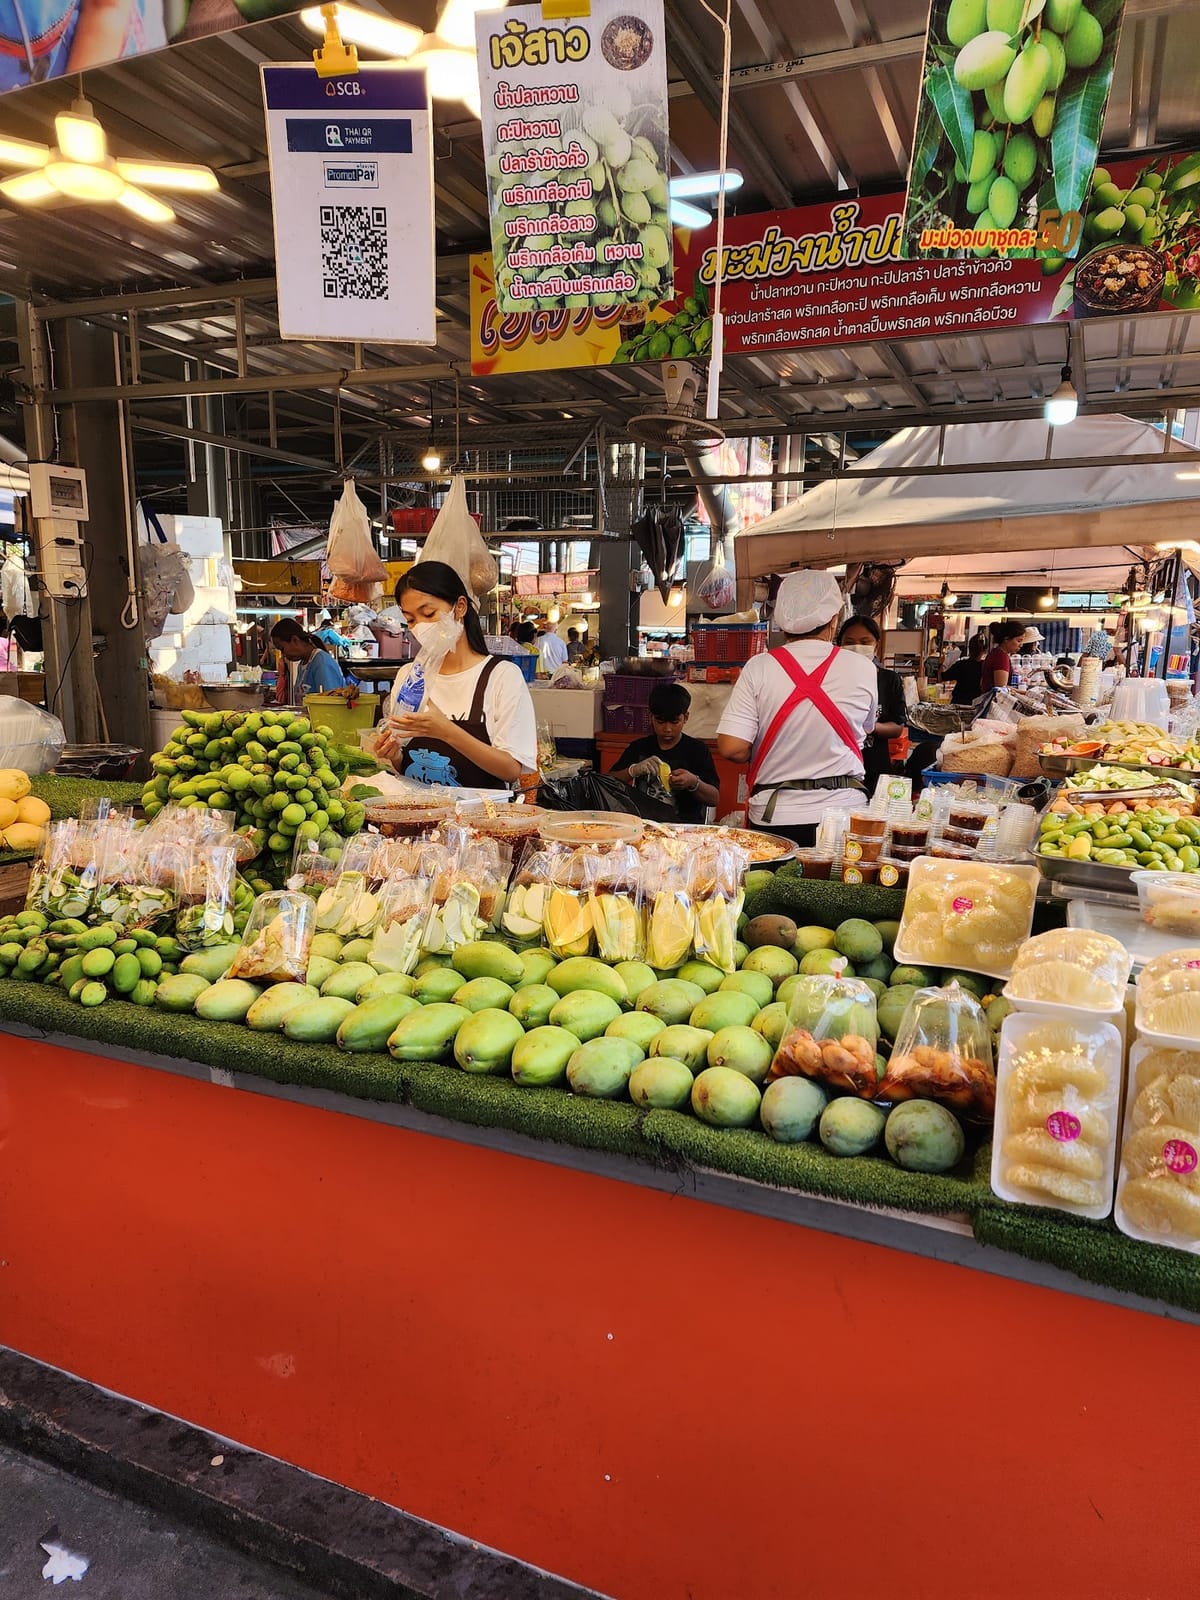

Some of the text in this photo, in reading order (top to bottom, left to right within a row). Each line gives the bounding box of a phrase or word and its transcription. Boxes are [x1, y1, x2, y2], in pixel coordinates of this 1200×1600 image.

[337, 81, 360, 96] SCB
[495, 81, 578, 108] น้ำปลาหวาน
[345, 127, 372, 136] THAI QR
[345, 137, 372, 145] PAYMENT
[497, 118, 560, 141] กะปิหวาน
[502, 179, 593, 206] พริกเกลือกะปิ
[505, 213, 597, 237] พริกเกลือลาว
[920, 221, 1037, 253] มะม่วงเบาชุดละ
[507, 242, 643, 268] พริกเกลือเค็ม หวาน
[725, 307, 792, 325] แจ่วปลาร้าสด
[871, 287, 946, 309] พริกเกลือเค็ม
[950, 280, 1041, 301] พริกเกลือหวาน
[750, 283, 814, 301] น้ำปลาหวาน
[742, 326, 831, 345] พริกเกลือพริกสด
